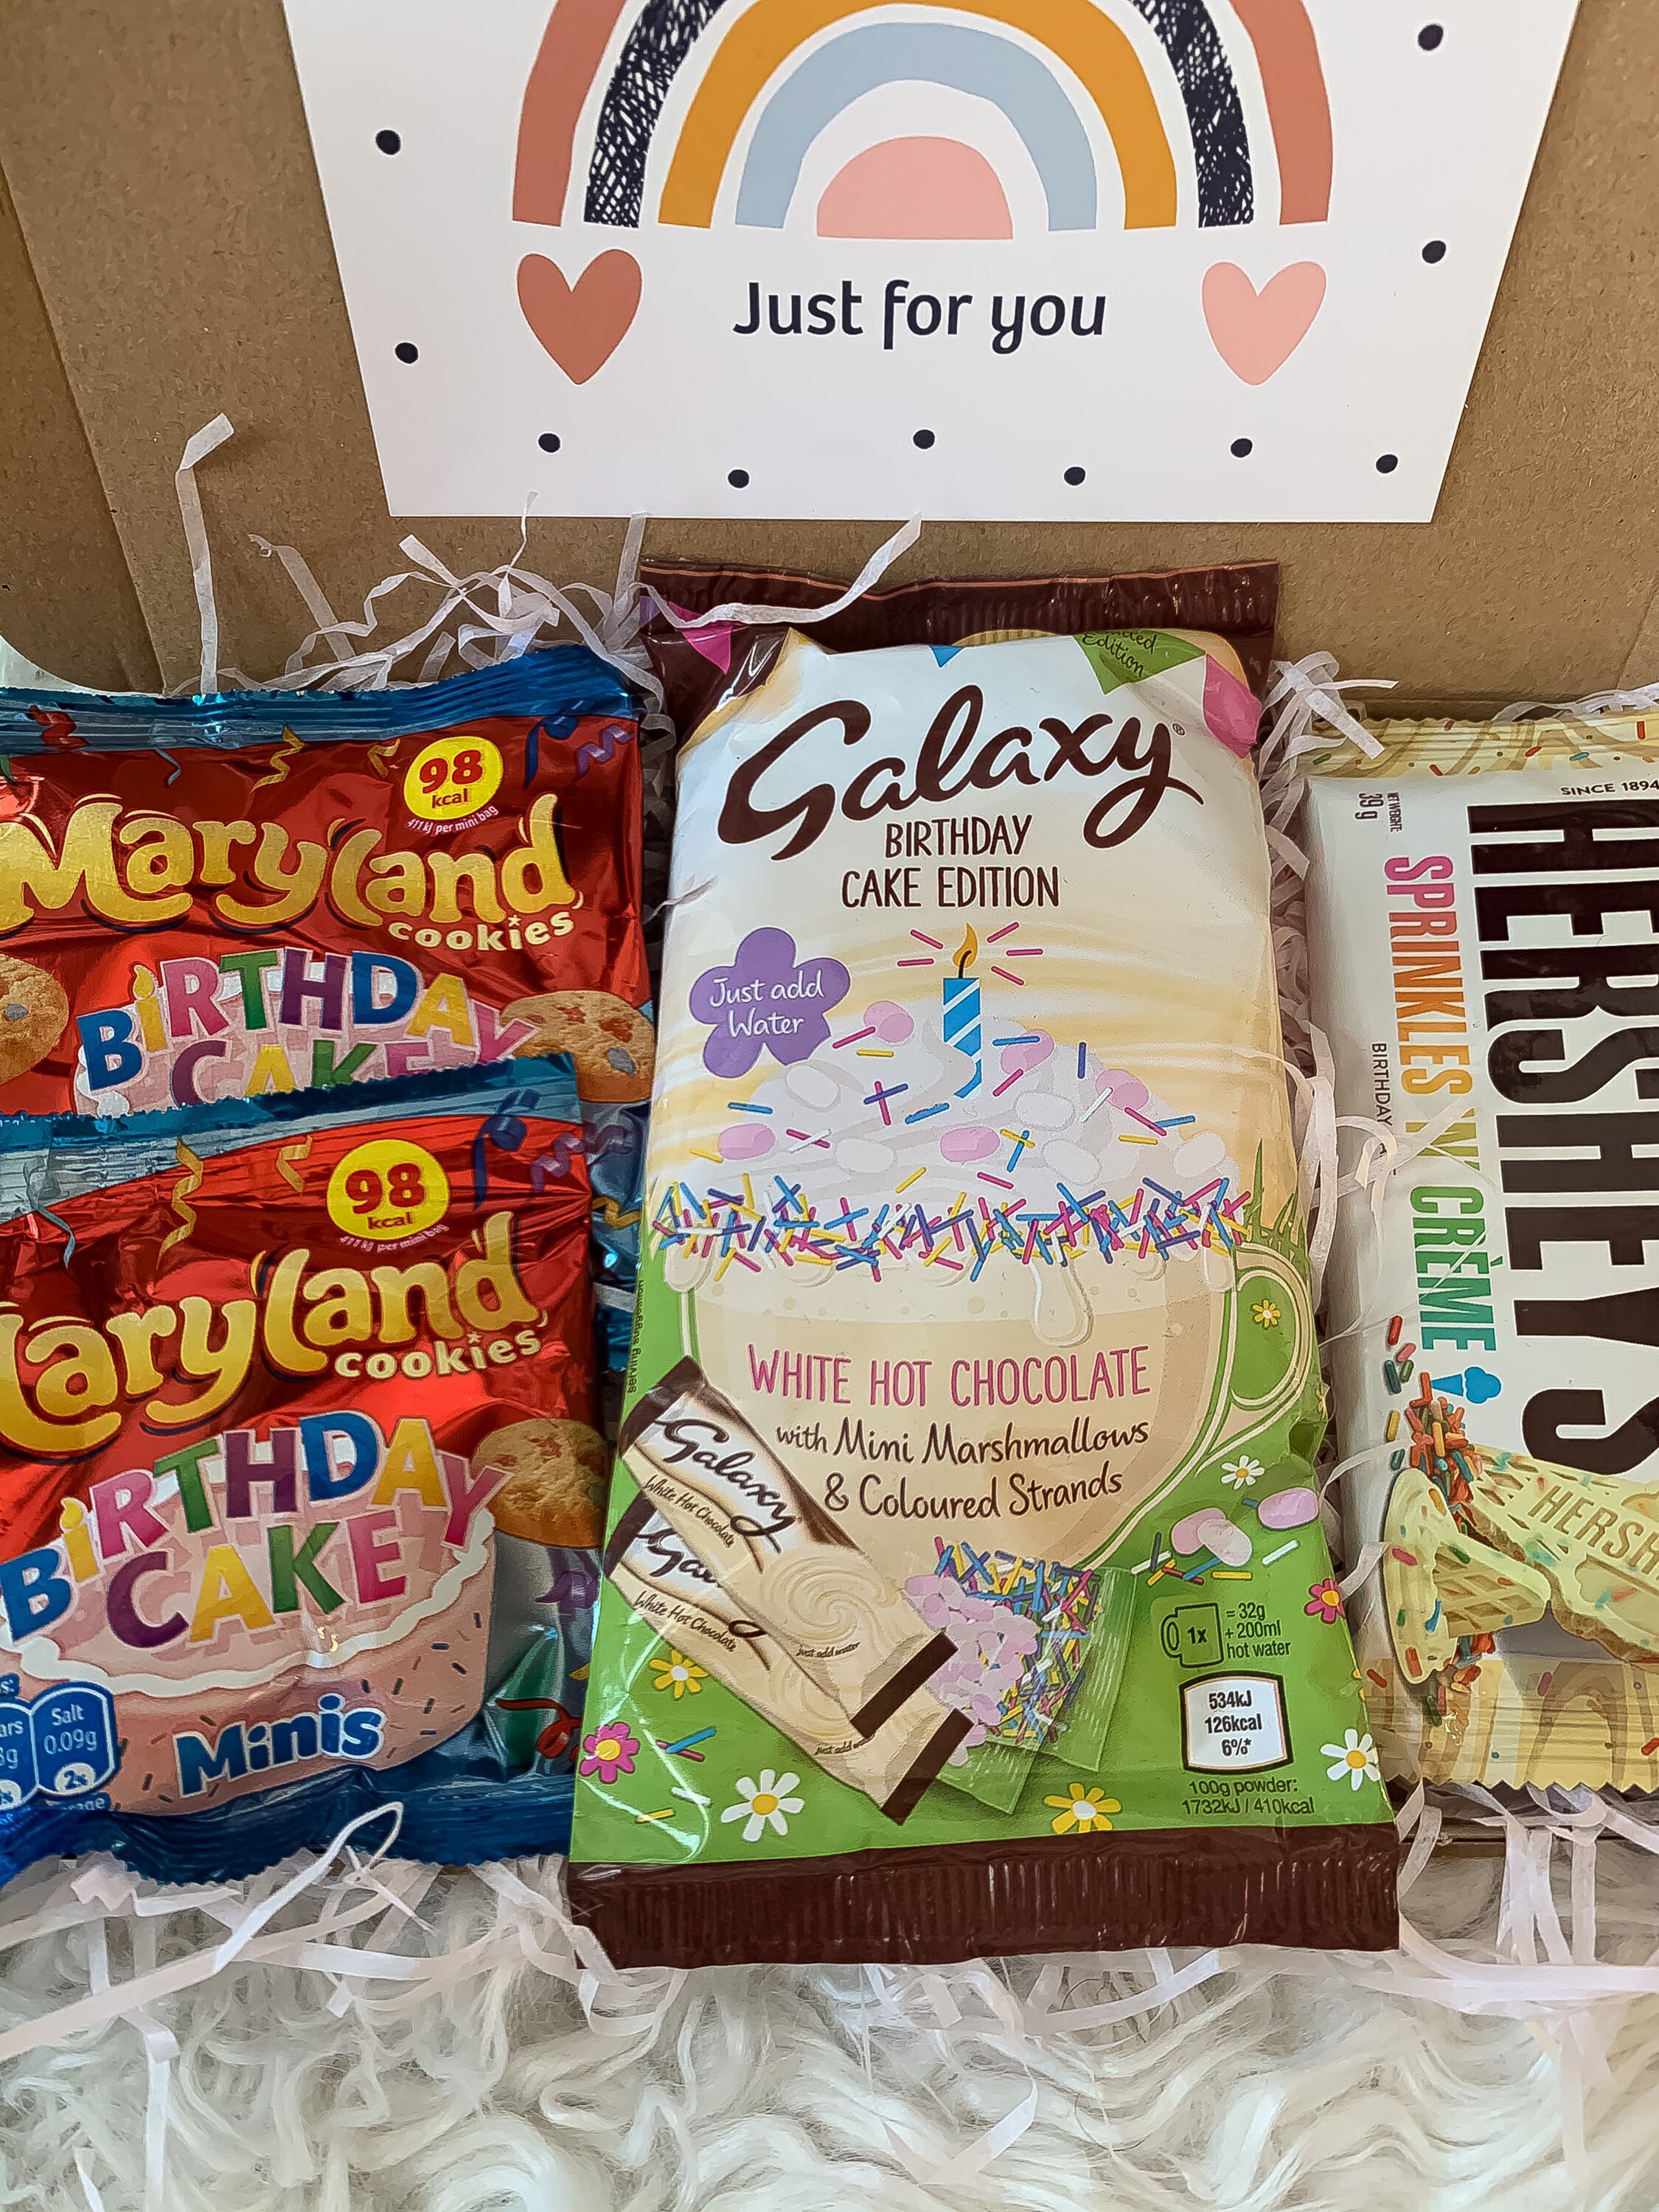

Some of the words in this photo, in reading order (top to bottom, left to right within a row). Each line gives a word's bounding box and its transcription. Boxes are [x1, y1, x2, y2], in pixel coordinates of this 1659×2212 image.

[732, 280, 863, 335] Just
[883, 279, 973, 350] for
[992, 295, 1106, 355] you
[1082, 633, 1144, 678] Edition
[419, 749, 483, 794] 98
[718, 685, 1204, 861] Galaxy
[1560, 783, 1616, 796] SINCE
[431, 787, 469, 809] kcal
[1354, 810, 1378, 820] g
[1358, 793, 1384, 808] 39
[435, 821, 455, 835] per
[455, 816, 479, 830] mini
[479, 805, 499, 821] bag
[885, 815, 1032, 859] BIRTHDAY
[0, 793, 575, 930] Maryland
[841, 868, 923, 908] CAKE
[938, 866, 1060, 908] EDITION
[388, 907, 575, 951] cookies
[709, 977, 766, 1007] Just
[771, 970, 824, 999] add
[1383, 855, 1475, 1095] SPRINKLES
[728, 1006, 805, 1037] Water
[1371, 1043, 1393, 1127] BIRTHDAY
[345, 1163, 425, 1214] 98
[368, 1211, 413, 1230] kcal
[377, 1242, 397, 1253] per
[426, 1224, 450, 1239] bag
[1410, 1186, 1503, 1352] CRÈME
[333, 1329, 541, 1380] cookies
[628, 1348, 641, 1394] serving
[747, 1343, 852, 1405] WHITE
[870, 1360, 933, 1407] HOT
[950, 1346, 1151, 1407] CHOCOLATE
[776, 1422, 828, 1455] with
[834, 1416, 915, 1464] Mini
[922, 1416, 1150, 1465] Marshmallows
[655, 1418, 796, 1554] Galaxy
[824, 1474, 849, 1512] &
[859, 1473, 1000, 1520] Coloured
[1009, 1460, 1124, 1516] Strands
[642, 1474, 677, 1502] White
[675, 1492, 695, 1512] Hot
[695, 1506, 735, 1548] Chocolate
[106, 1512, 406, 1649] CAKE
[634, 1590, 668, 1616] White
[667, 1604, 693, 1624] Hot
[690, 1618, 737, 1653] Chocolate
[1238, 1601, 1266, 1620] 32g
[816, 1646, 834, 1658] add
[1186, 1626, 1208, 1645] 1x
[1226, 1641, 1249, 1659] hot
[1253, 1641, 1292, 1657] water
[51, 1703, 85, 1726] Salt
[1208, 1689, 1252, 1710] 534kJ
[44, 1728, 97, 1755] 0.09g
[1204, 1713, 1262, 1734] 126kcal
[173, 1694, 386, 1799] Minis
[833, 1740, 852, 1754] add
[1181, 1797, 1240, 1815] 1732kJ
[1254, 1796, 1315, 1815] 410kcal
[1189, 1779, 1231, 1797] 100g
[1234, 1777, 1298, 1796] powder:
